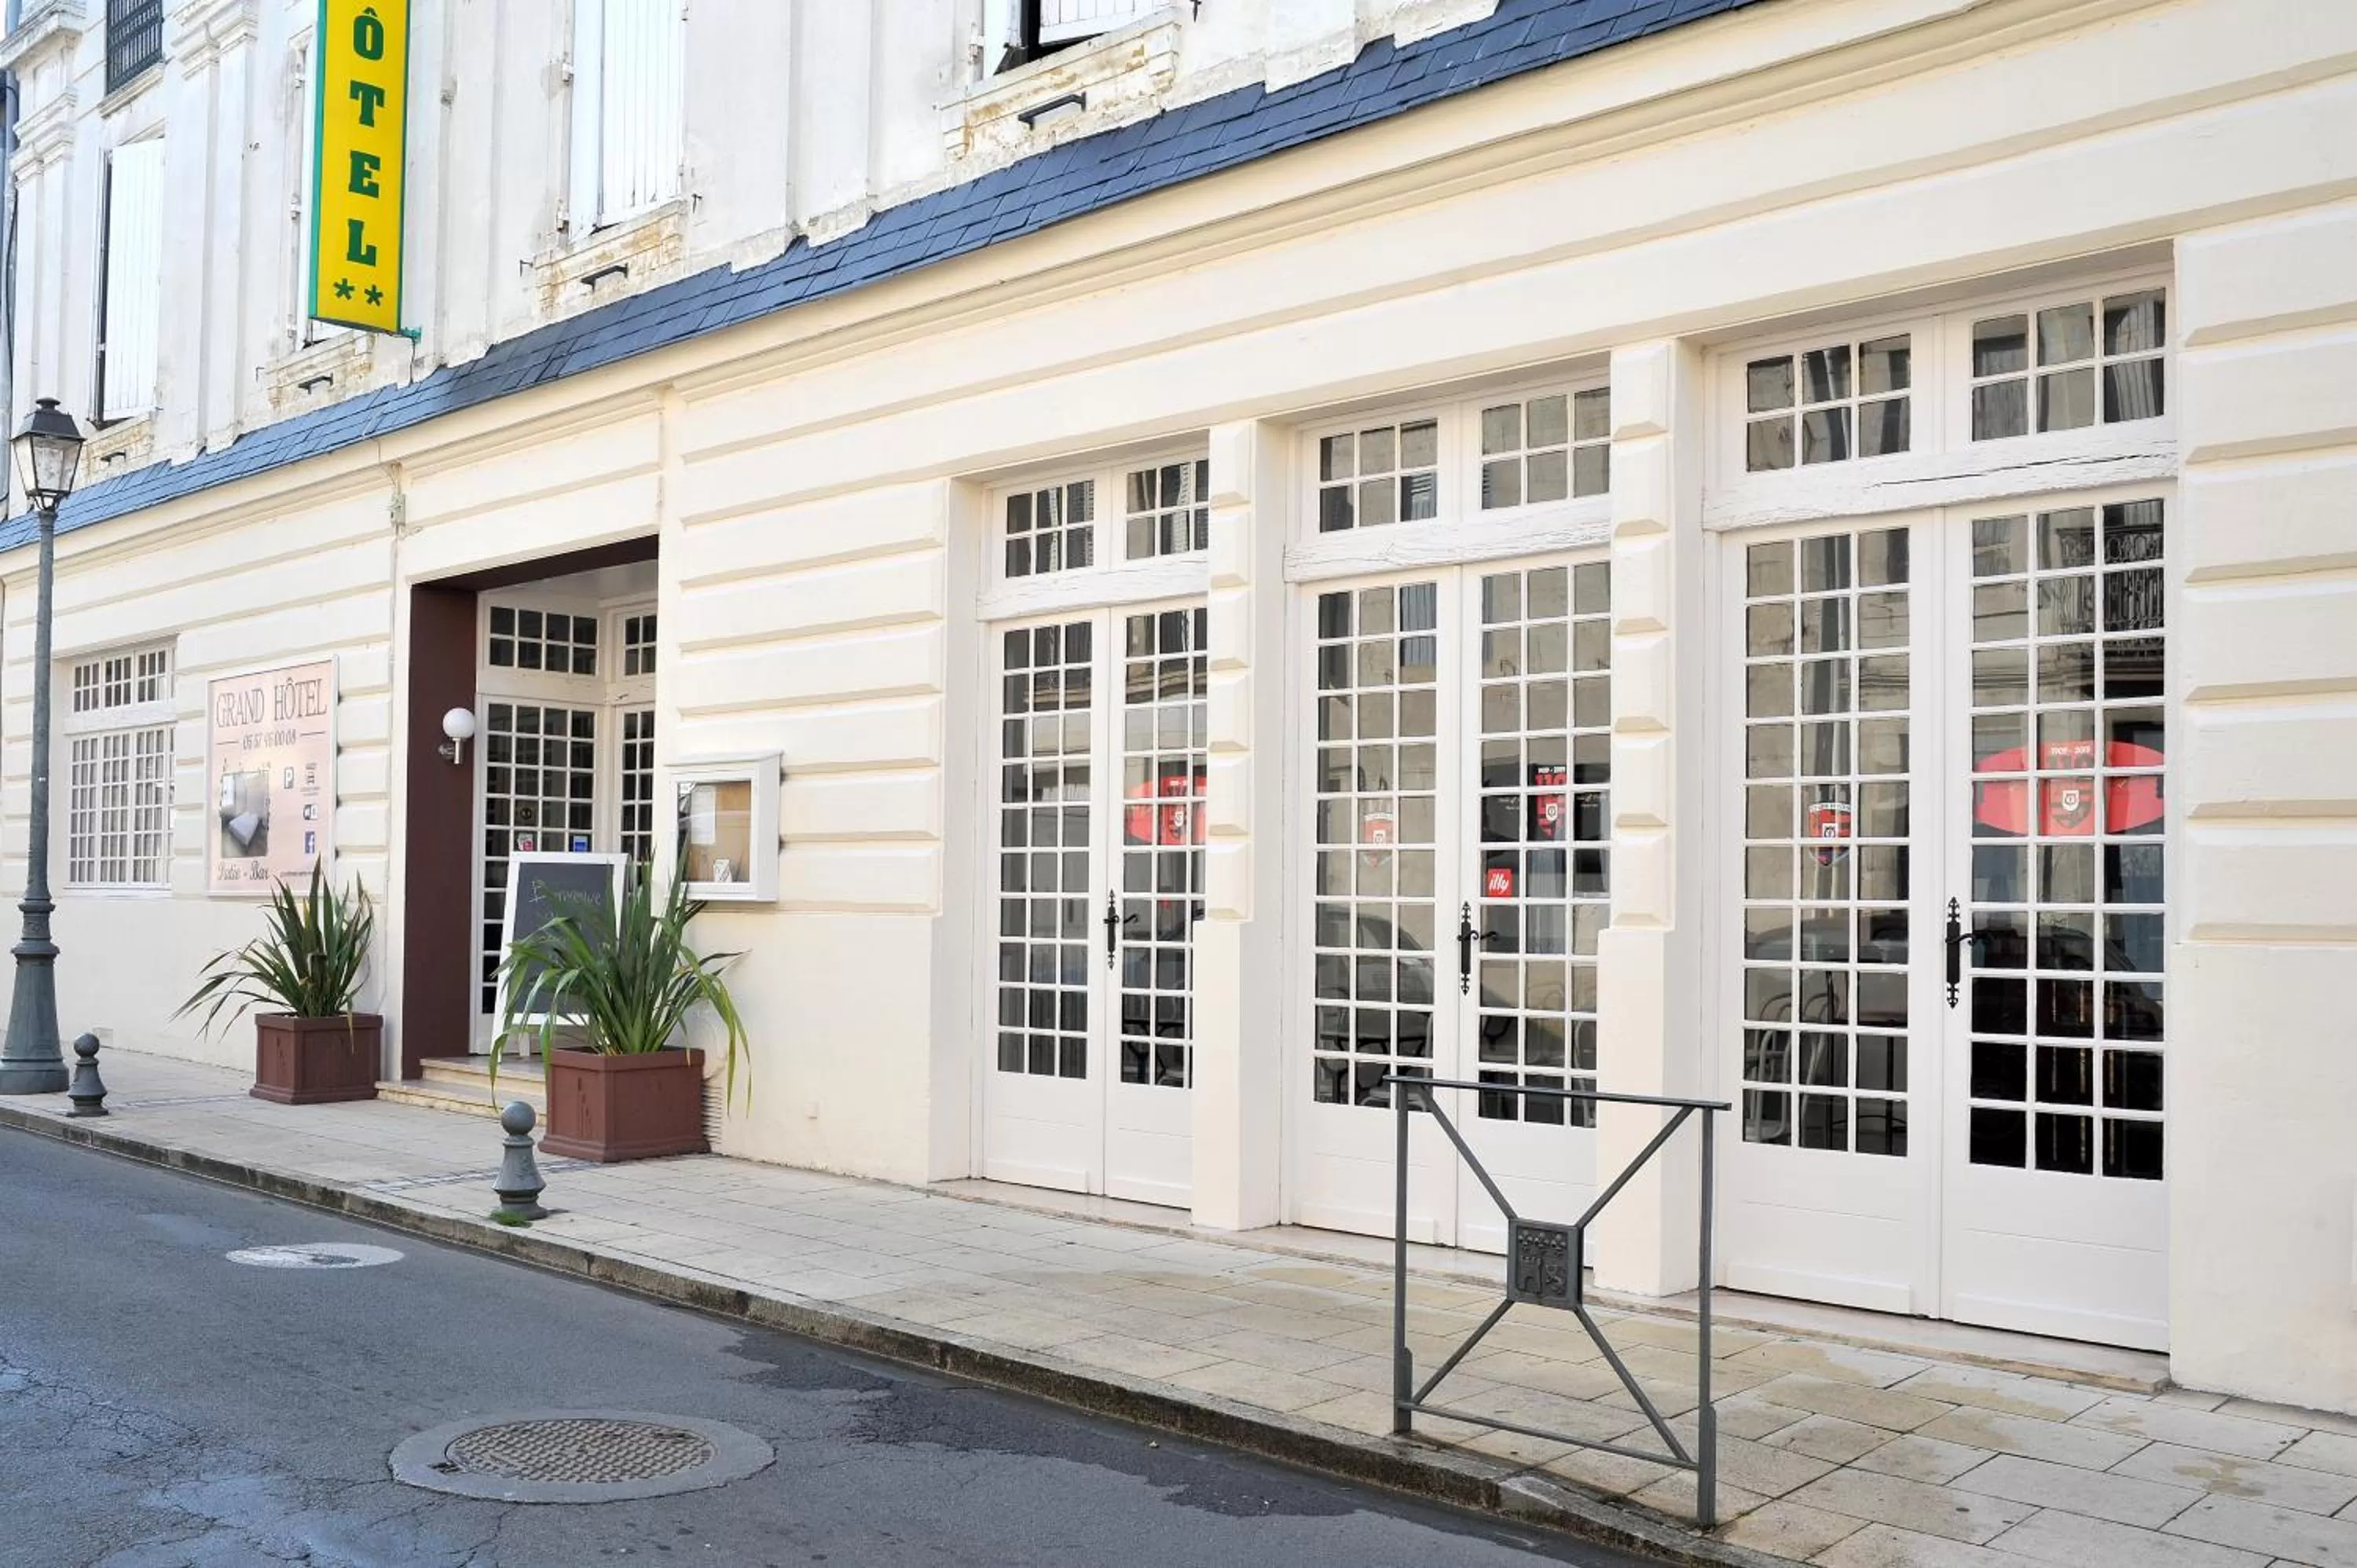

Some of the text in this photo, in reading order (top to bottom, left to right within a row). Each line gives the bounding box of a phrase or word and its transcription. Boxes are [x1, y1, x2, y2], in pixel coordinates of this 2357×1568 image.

[216, 676, 327, 727] GRAND HÔTEL
[1489, 872, 1509, 894] illy
